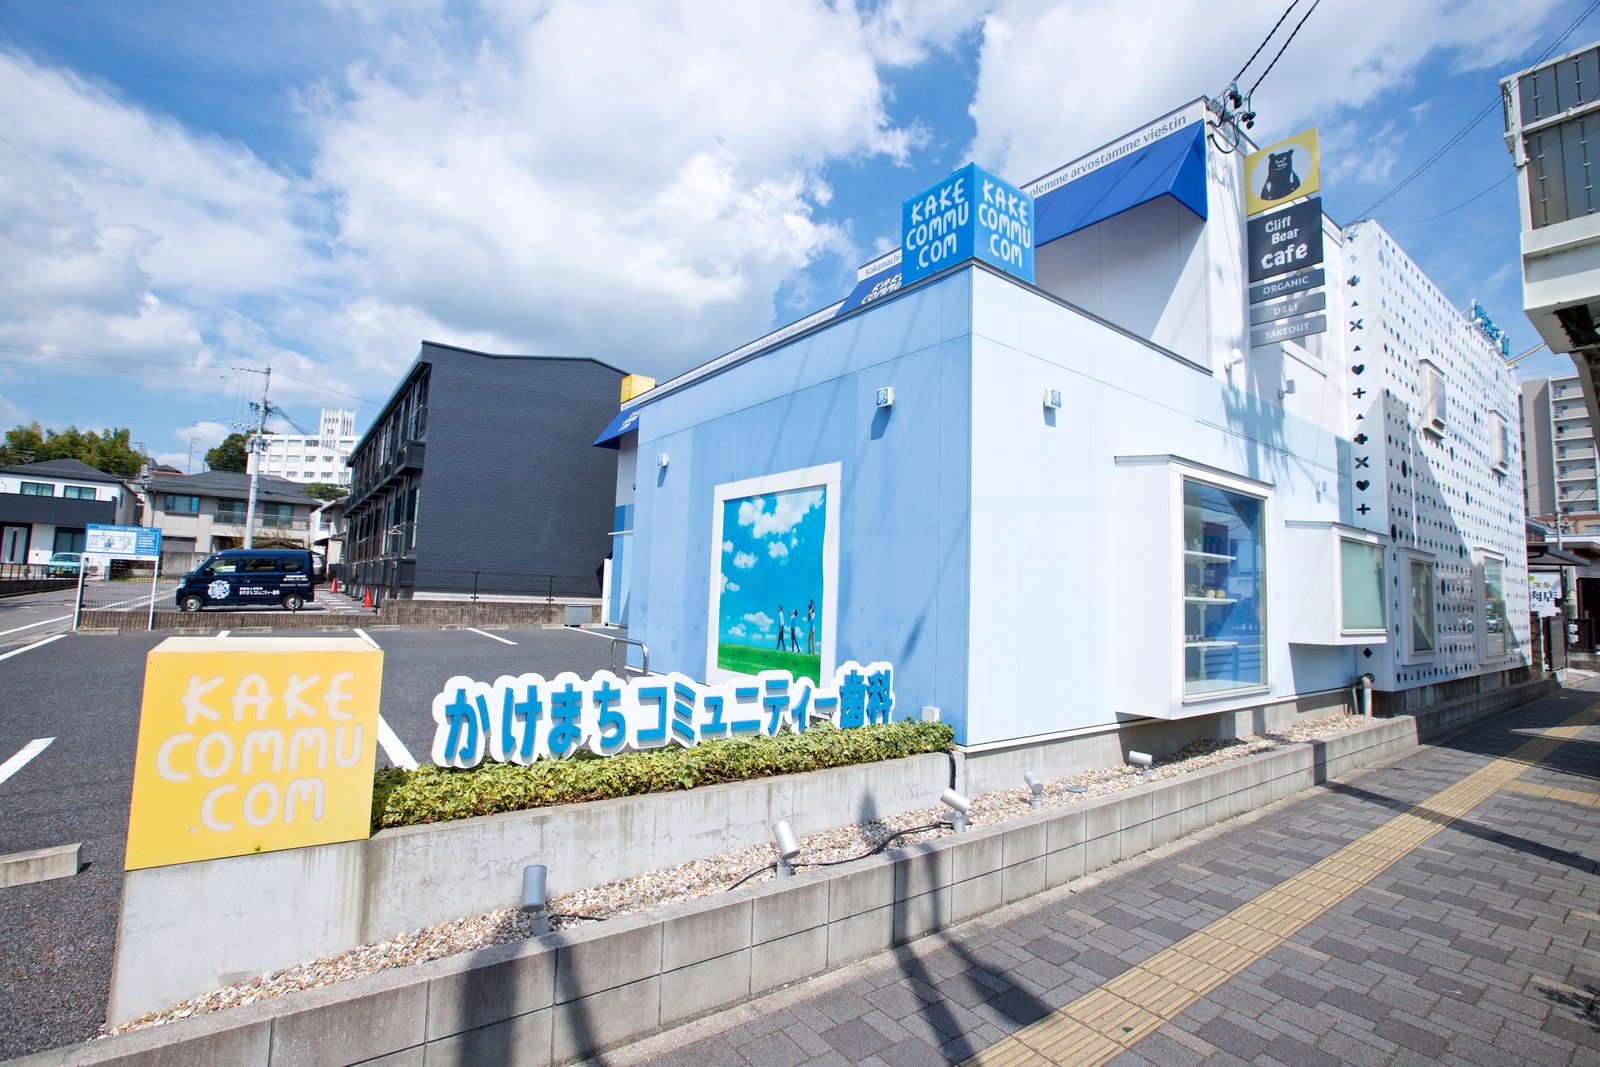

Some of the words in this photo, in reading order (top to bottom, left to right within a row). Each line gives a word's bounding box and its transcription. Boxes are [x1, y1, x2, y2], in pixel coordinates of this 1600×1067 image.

[1071, 138, 1141, 179] arvostamme
[1143, 114, 1187, 143] viestin
[911, 177, 965, 227] KAKE
[983, 178, 1029, 226] KAKE
[906, 200, 969, 251] COMMU
[978, 203, 1031, 249] COMMU
[1264, 215, 1292, 233] Cliff
[1272, 227, 1300, 245] Bear
[916, 232, 957, 271] .COM
[988, 233, 1023, 269] .COM
[1261, 242, 1309, 270] cafe
[872, 272, 902, 294] KAK
[1263, 275, 1310, 295] ORGANIC
[1274, 302, 1298, 316] DELI
[1264, 322, 1310, 341] TAKEOUT
[180, 671, 356, 724] KAKE
[444, 669, 894, 760] かけまちコミュニティー歯科
[155, 722, 363, 782] COMMU
[188, 776, 325, 836] .COM
